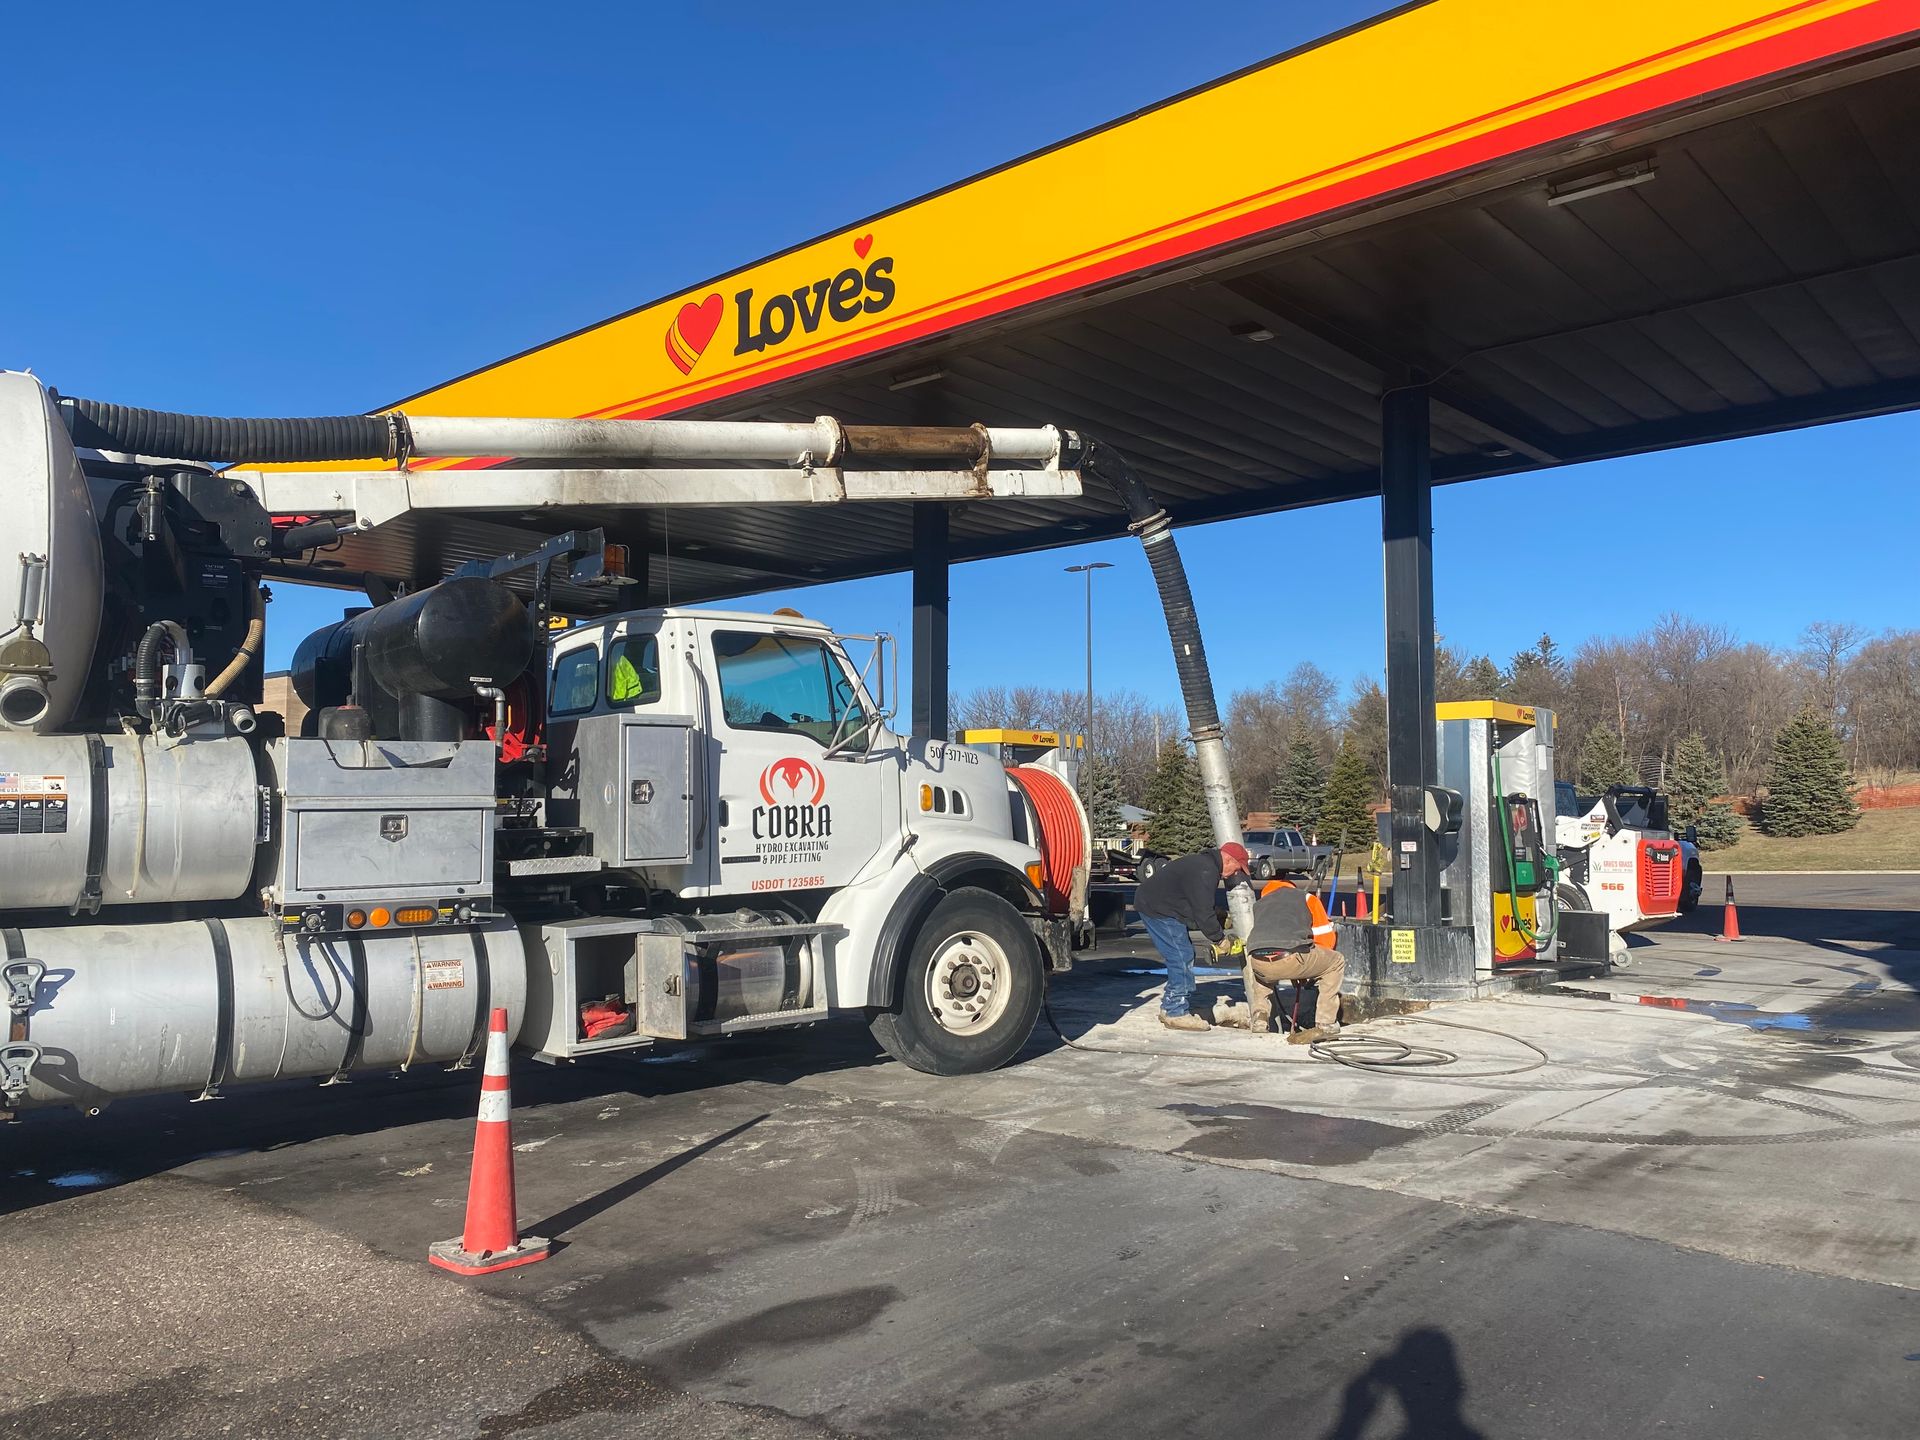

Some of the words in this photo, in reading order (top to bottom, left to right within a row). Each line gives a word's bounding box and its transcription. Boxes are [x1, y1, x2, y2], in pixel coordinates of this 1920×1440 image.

[1039, 734, 1055, 744] Love's
[930, 746, 979, 765] 507-377-1123
[752, 804, 832, 840] COBRA
[755, 842, 783, 854] HYDRO
[784, 841, 829, 852] EXCAVATING
[762, 855, 768, 865] &
[770, 854, 788, 865] PIPE
[789, 852, 822, 864] JETTING
[751, 878, 785, 891] USDOT
[787, 876, 825, 888] 1235855
[1511, 913, 1532, 931] Le's
